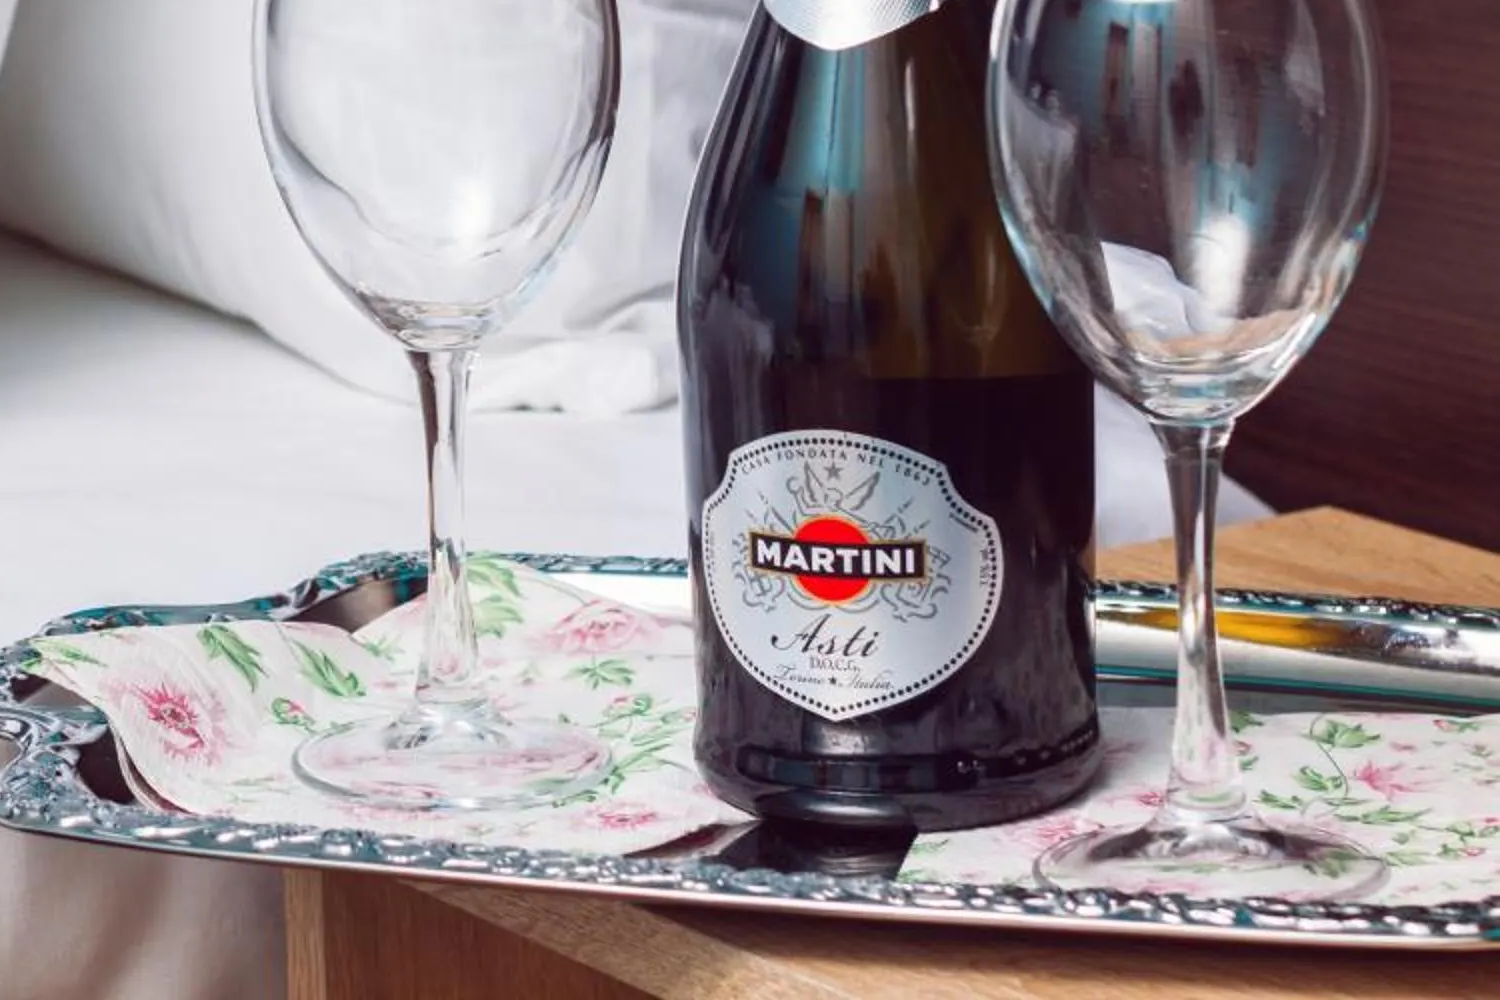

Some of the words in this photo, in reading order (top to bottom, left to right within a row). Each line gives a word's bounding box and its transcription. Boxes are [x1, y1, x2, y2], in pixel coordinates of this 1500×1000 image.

[777, 447, 847, 461] FONDATA
[858, 453, 884, 468] NEL
[756, 538, 916, 575] MARTINI
[771, 613, 879, 657] Asti
